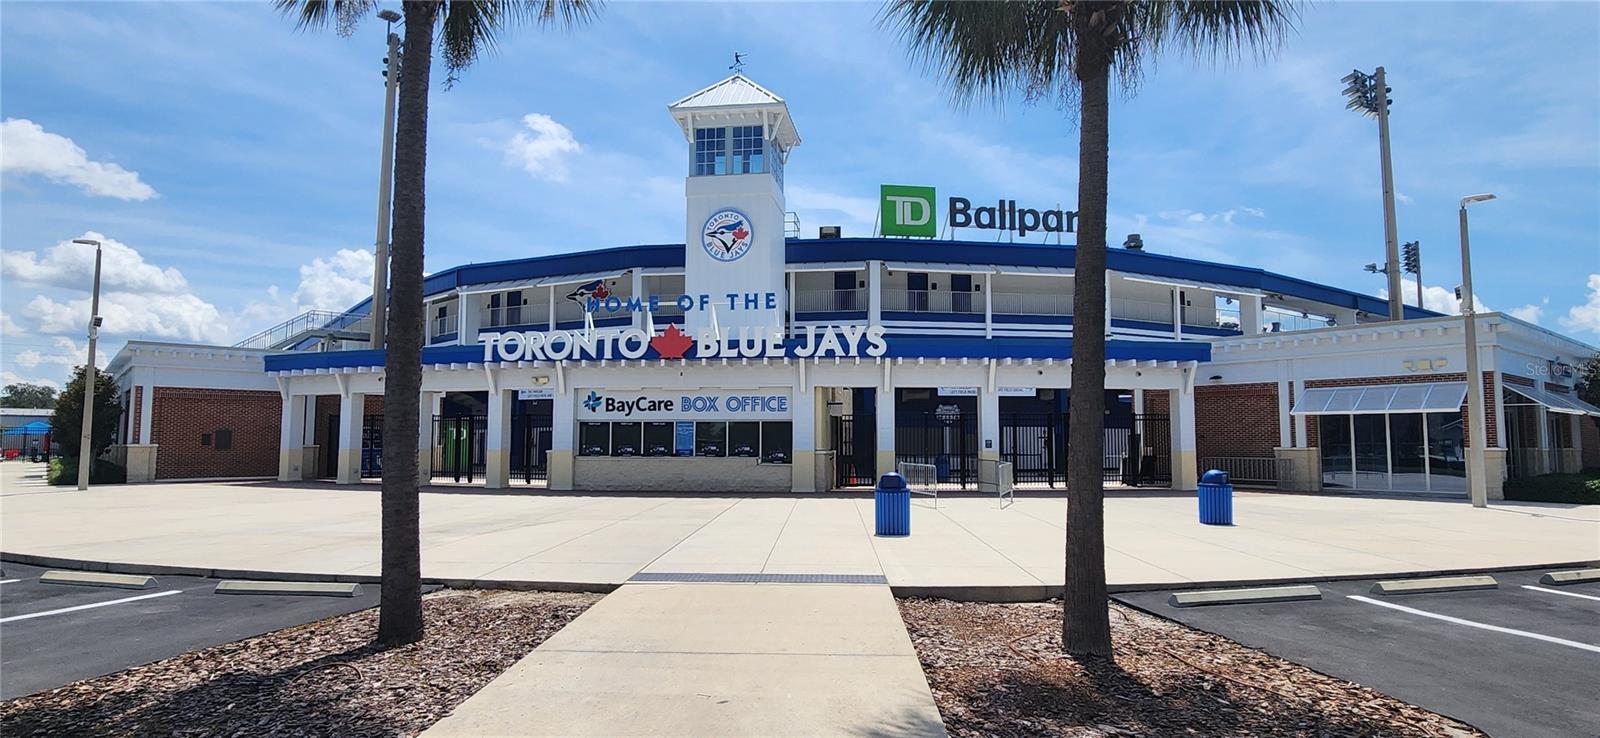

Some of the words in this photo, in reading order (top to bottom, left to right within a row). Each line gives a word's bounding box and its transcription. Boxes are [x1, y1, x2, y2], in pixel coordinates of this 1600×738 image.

[706, 213, 740, 231] TORONTO
[886, 195, 931, 226] TD
[949, 197, 1080, 237] Ballpar
[706, 241, 726, 258] BLUE
[729, 241, 749, 259] JAYS
[586, 295, 660, 313] HOME
[676, 294, 710, 312] OF
[726, 292, 777, 311] THE
[478, 328, 650, 361] TORONTO
[695, 326, 786, 358] BLUE
[793, 324, 888, 358] JAYS
[605, 396, 674, 417] BayCare
[681, 396, 719, 412] BOX
[726, 396, 788, 412] OFFICE
